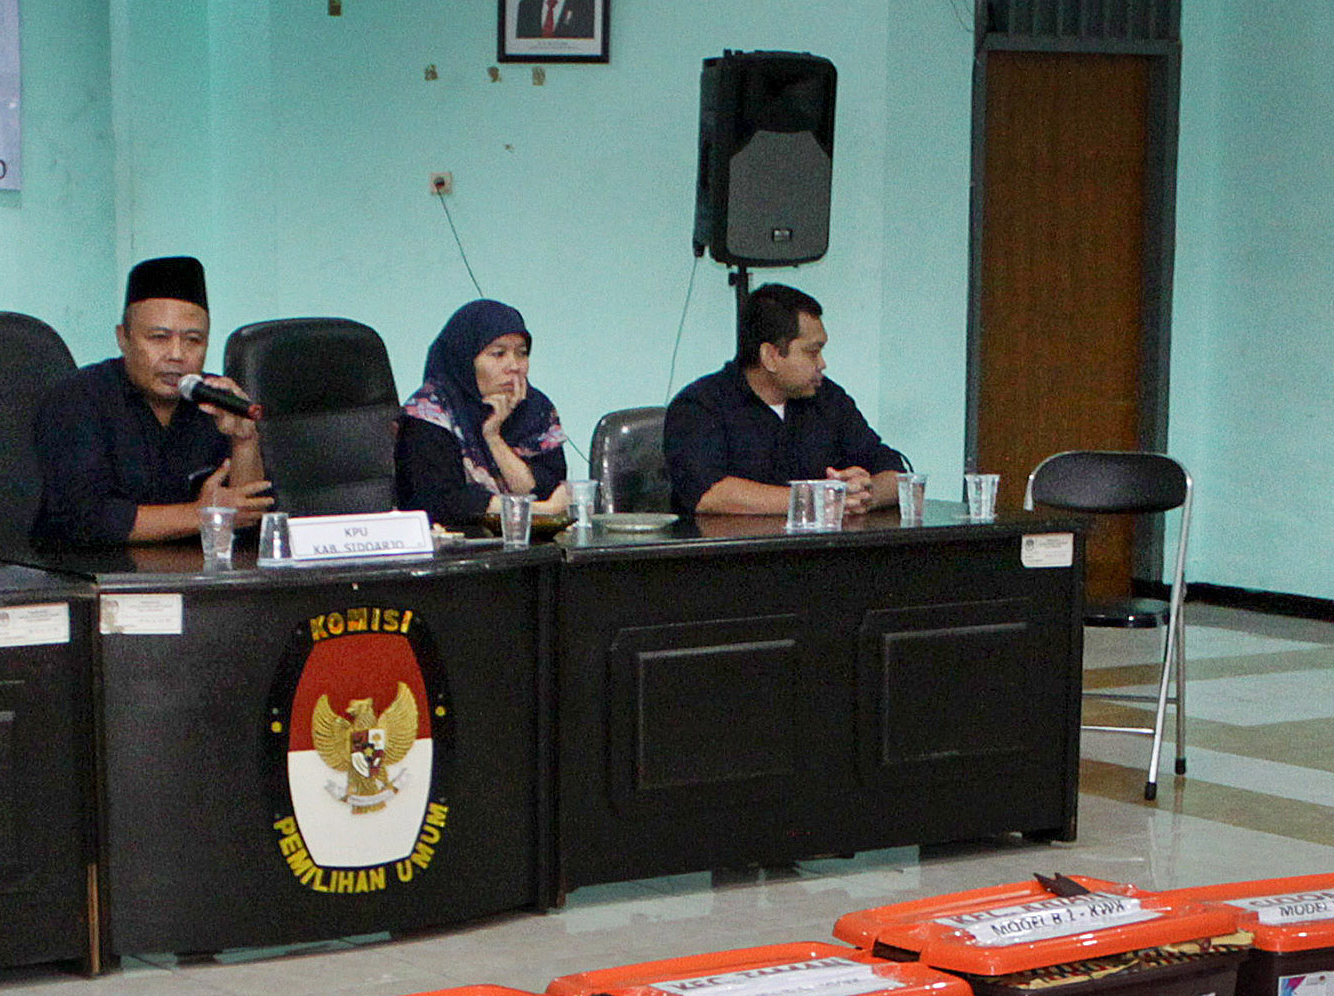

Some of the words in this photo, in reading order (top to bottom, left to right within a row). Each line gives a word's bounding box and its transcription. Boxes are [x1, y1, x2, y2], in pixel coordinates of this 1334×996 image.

[344, 527, 368, 538] KPU
[345, 540, 405, 553] SIDOARJO
[309, 607, 413, 641] KOMISI
[273, 816, 386, 893] PEMILIHAN
[396, 802, 449, 882] UMUM
